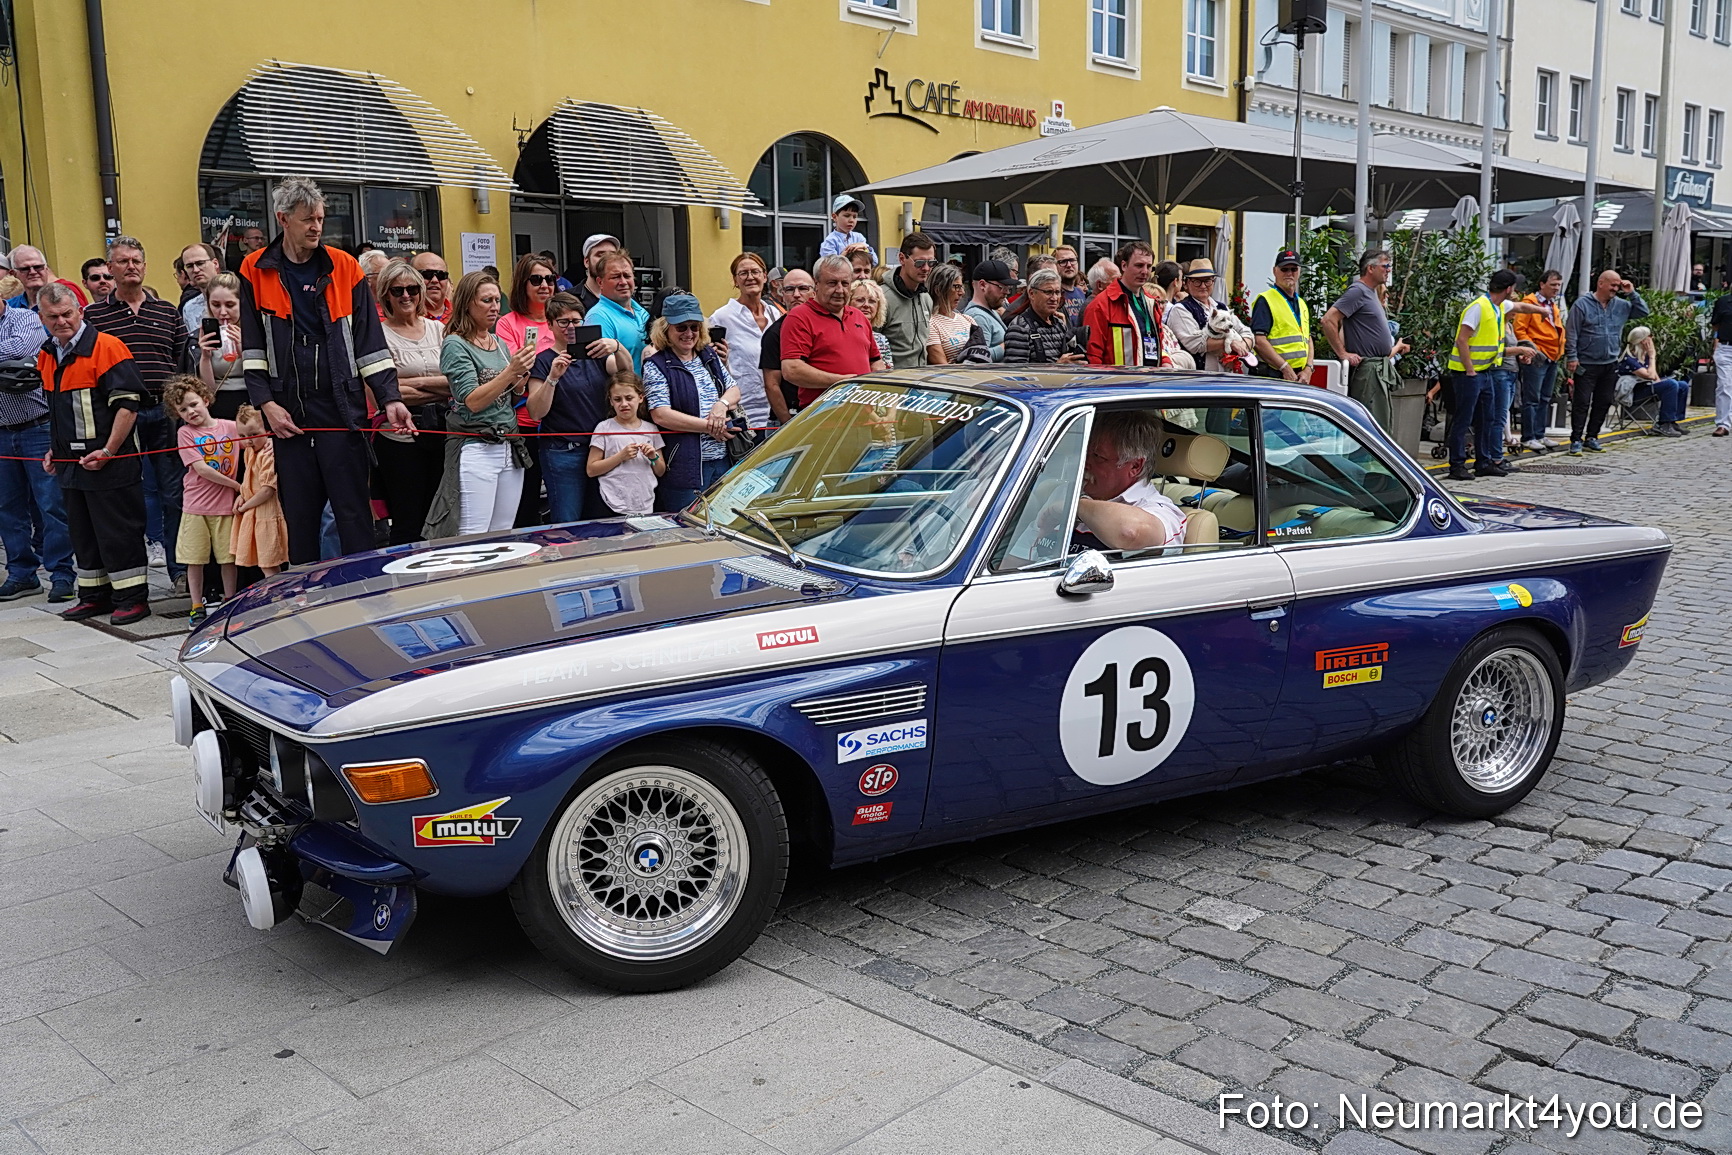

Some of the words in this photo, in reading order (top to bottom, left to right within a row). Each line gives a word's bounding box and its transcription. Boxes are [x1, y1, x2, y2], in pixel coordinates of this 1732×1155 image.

[906, 78, 960, 116] CAFÉ
[963, 100, 985, 121] AM
[986, 102, 1037, 128] RATHAUS
[235, 218, 260, 228] Bilder
[379, 226, 416, 235] Passbilder
[1275, 527, 1285, 536] U.
[761, 629, 816, 648] MOTUL
[519, 661, 588, 687] TEAM
[610, 637, 740, 673] SCHNITZER
[1315, 642, 1389, 671] PIRELLI
[1327, 672, 1358, 684] BOSCH
[1084, 656, 1171, 758] 13
[866, 725, 926, 746] SACHS
[865, 740, 926, 756] PERFORMANCE
[863, 767, 894, 789] STP
[856, 805, 884, 815] auto
[860, 810, 888, 819] motor
[436, 820, 507, 837] motul
